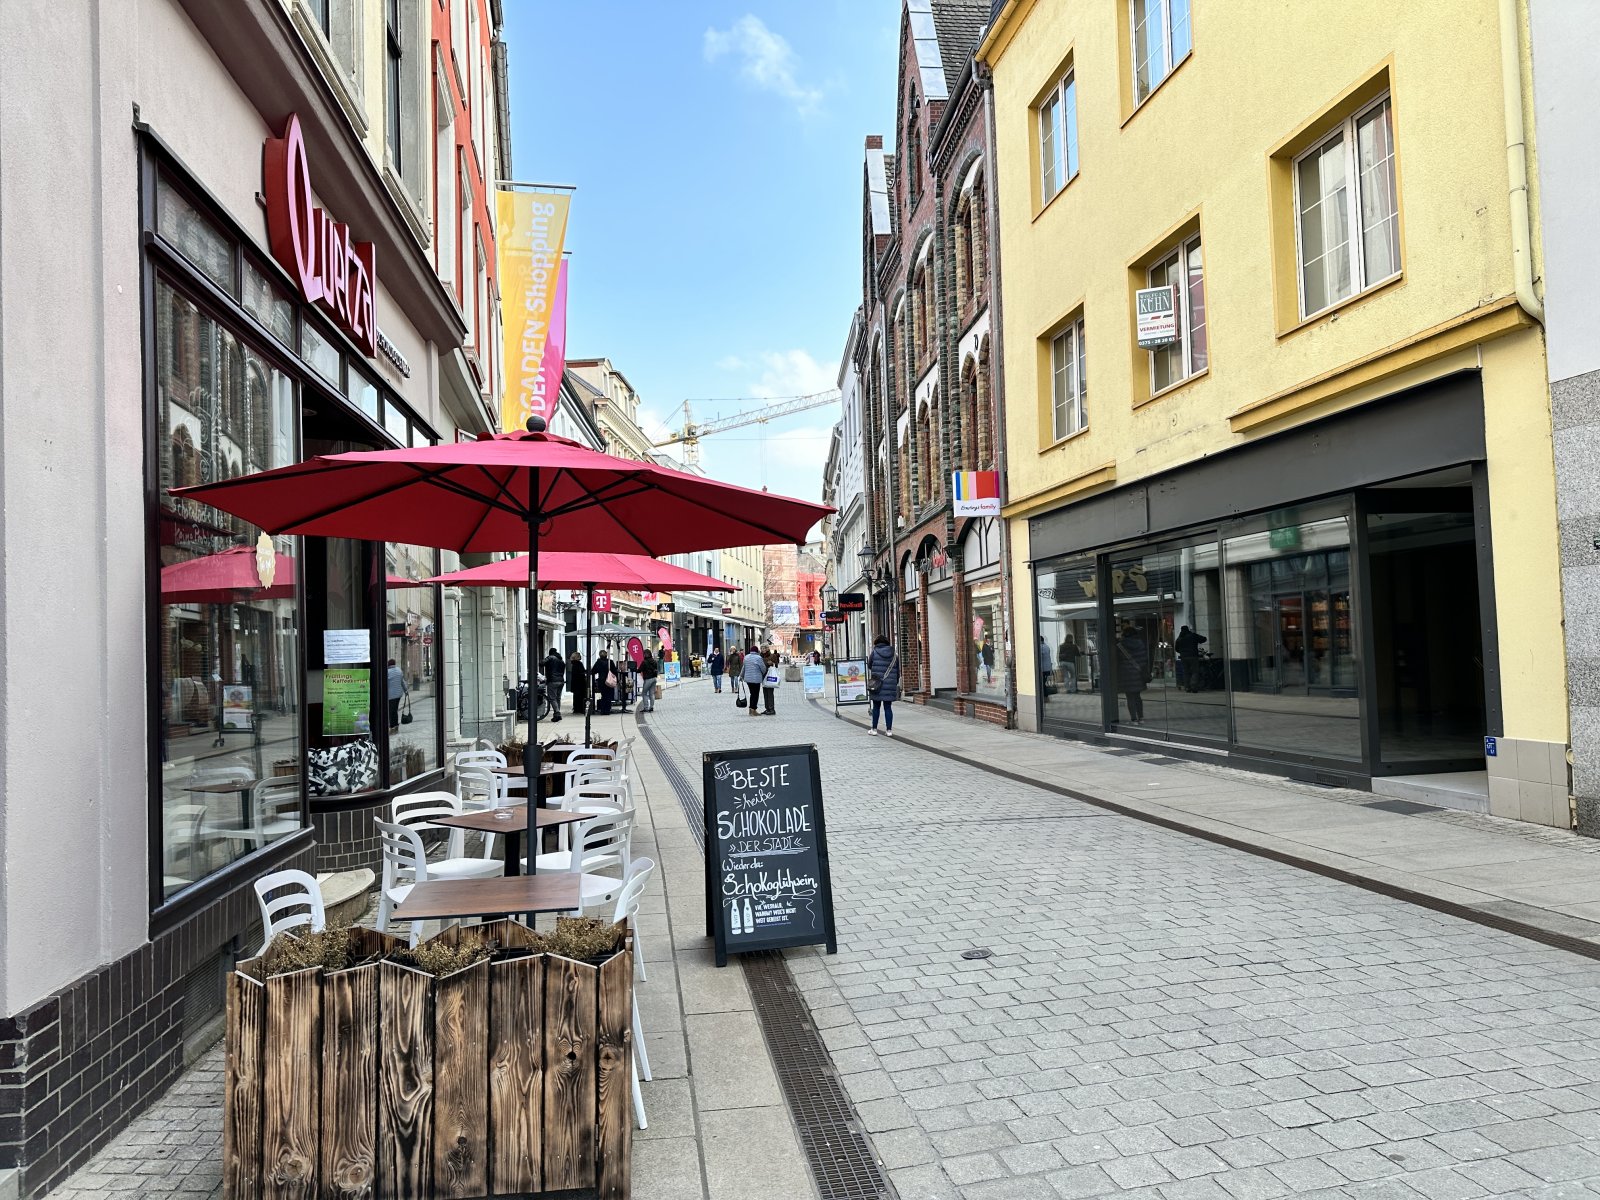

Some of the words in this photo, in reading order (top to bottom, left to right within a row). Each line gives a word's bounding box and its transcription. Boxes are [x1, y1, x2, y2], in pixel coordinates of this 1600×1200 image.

[525, 201, 555, 313] Shopping
[1140, 296, 1170, 313] KÜHN
[1140, 324, 1174, 332] VERMIETUNG
[595, 596, 607, 608] T
[632, 644, 639, 654] T
[715, 763, 731, 778] DIE
[731, 764, 789, 789] BESTE
[743, 789, 775, 809] heiße
[717, 805, 811, 839] SCHOKOLADE
[738, 840, 760, 853] DER
[762, 836, 794, 852] STADT
